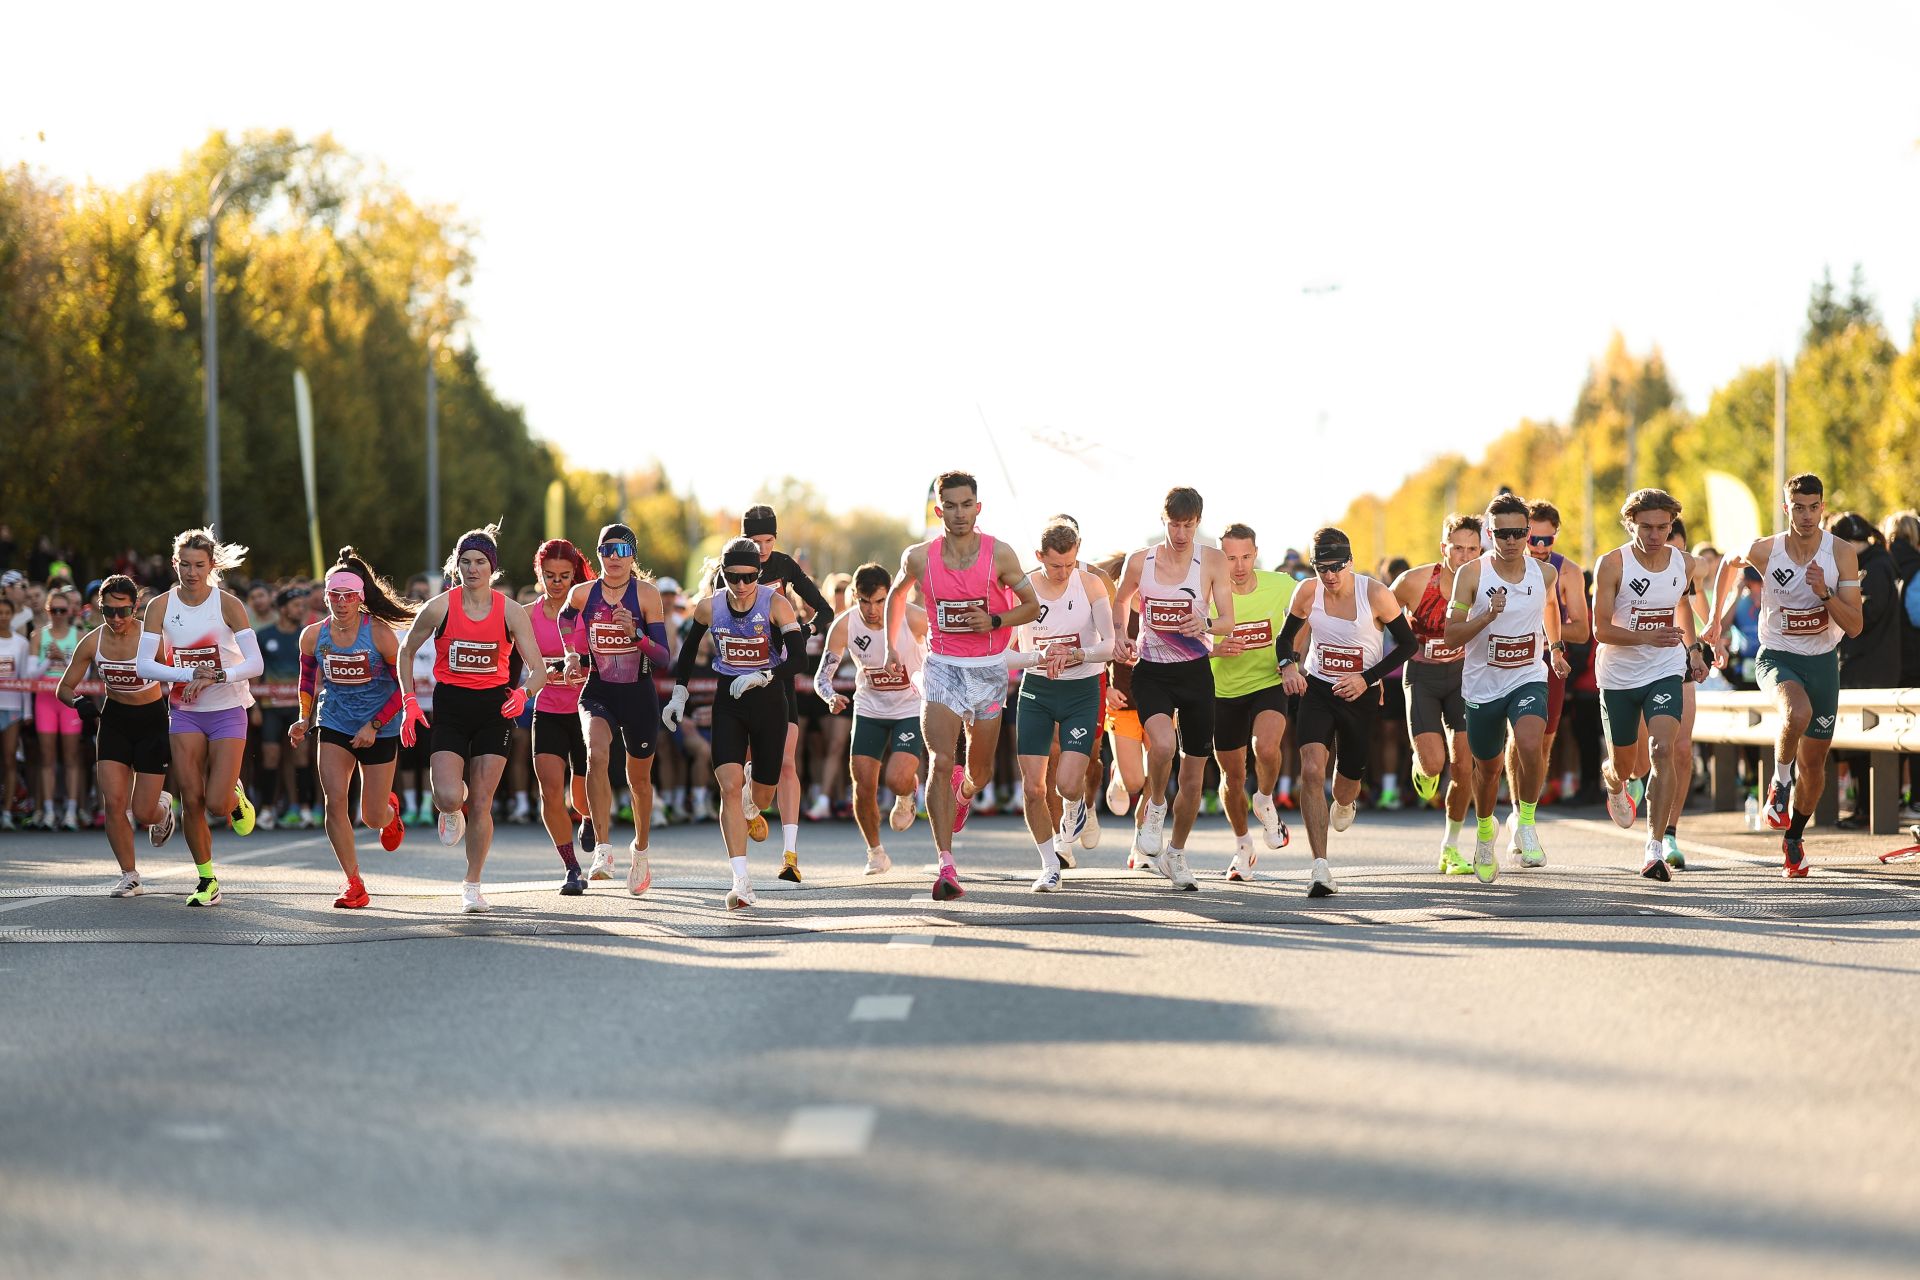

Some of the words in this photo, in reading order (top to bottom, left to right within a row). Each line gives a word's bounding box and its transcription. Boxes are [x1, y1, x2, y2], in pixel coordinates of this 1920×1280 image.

[1789, 618, 1821, 627] 5019
[597, 635, 632, 645] 5003
[728, 648, 760, 657] 5001
[1497, 648, 1529, 658] 5026
[183, 659, 216, 668] 5009
[458, 654, 491, 664] 5010
[1324, 657, 1354, 668] 5016
[332, 666, 365, 676] 5002
[106, 675, 137, 683] 5007
[873, 676, 903, 684] 5022
